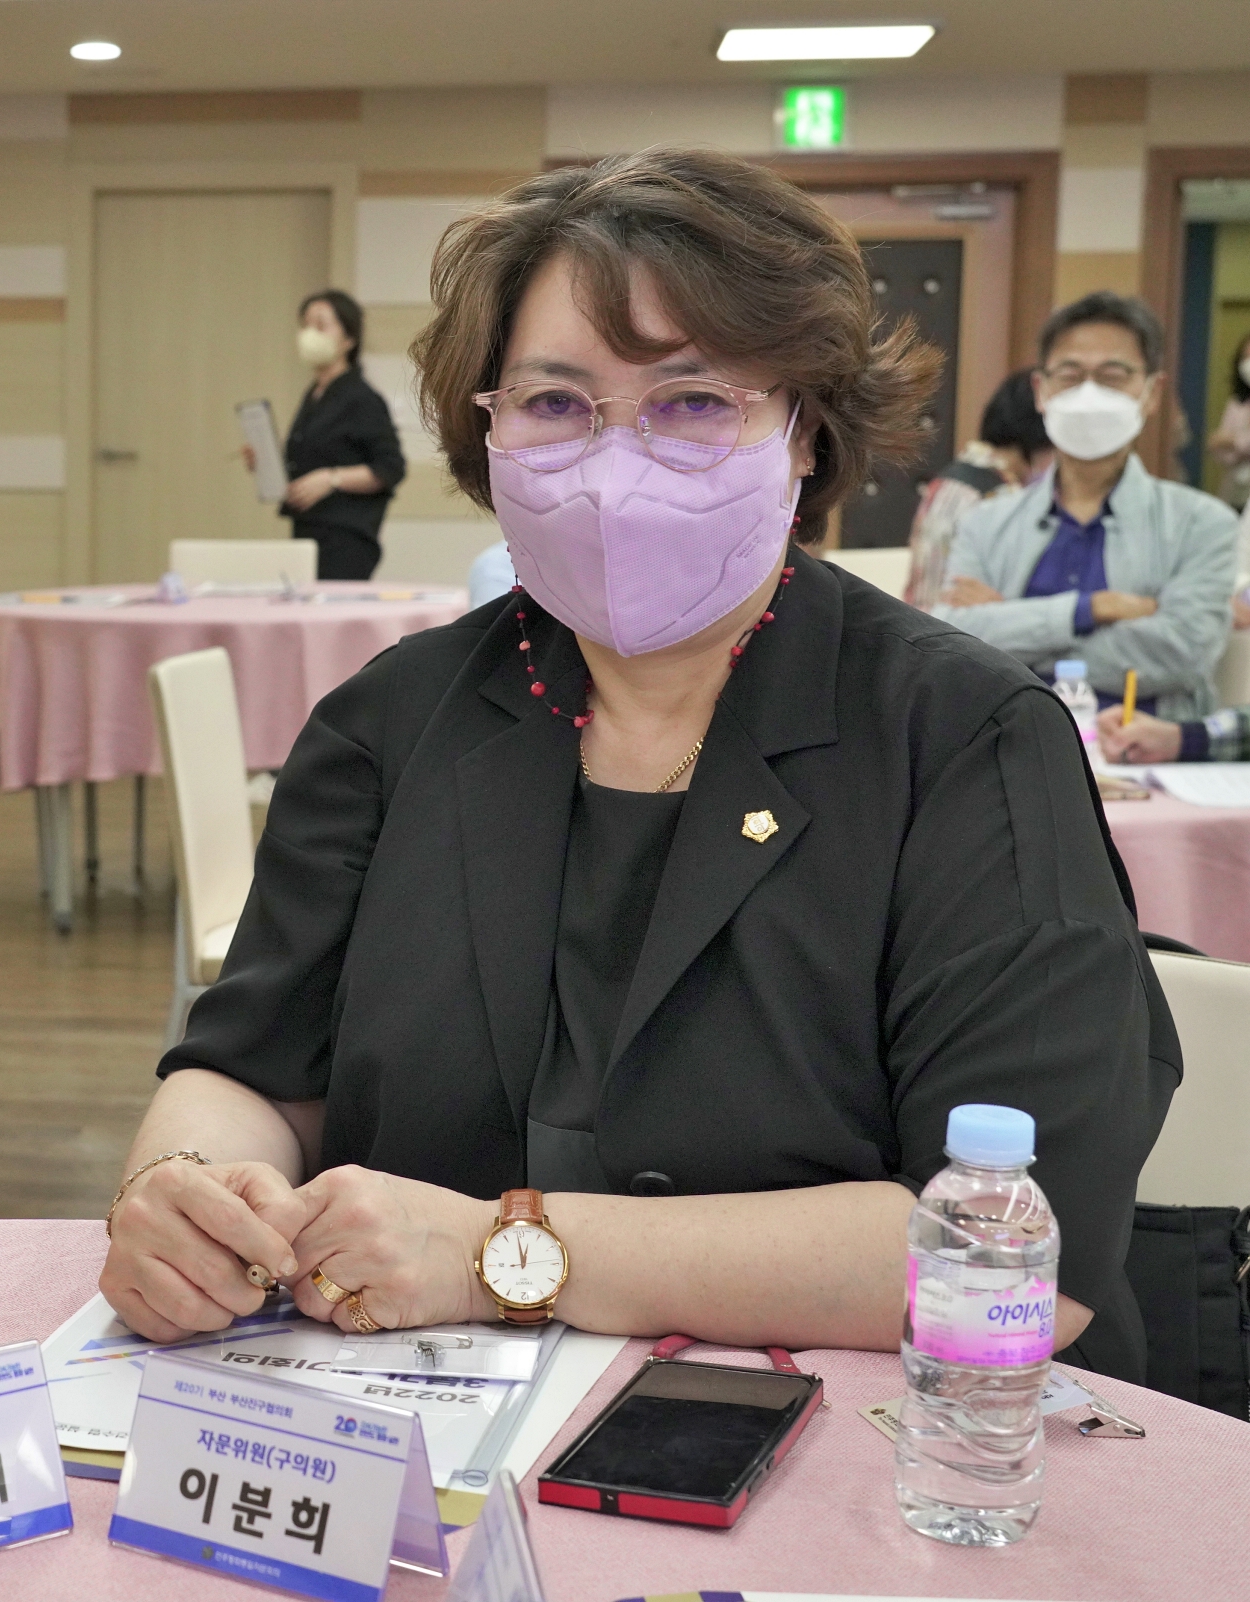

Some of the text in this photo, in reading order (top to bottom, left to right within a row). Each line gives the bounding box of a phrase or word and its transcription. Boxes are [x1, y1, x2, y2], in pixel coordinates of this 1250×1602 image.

[221, 1352, 363, 1376] 기회의
[174, 1380, 294, 1419] 제20기 부산 부산진구협의회
[362, 1384, 481, 1404] 2022년
[197, 1428, 336, 1485] 자문위원(구의원)
